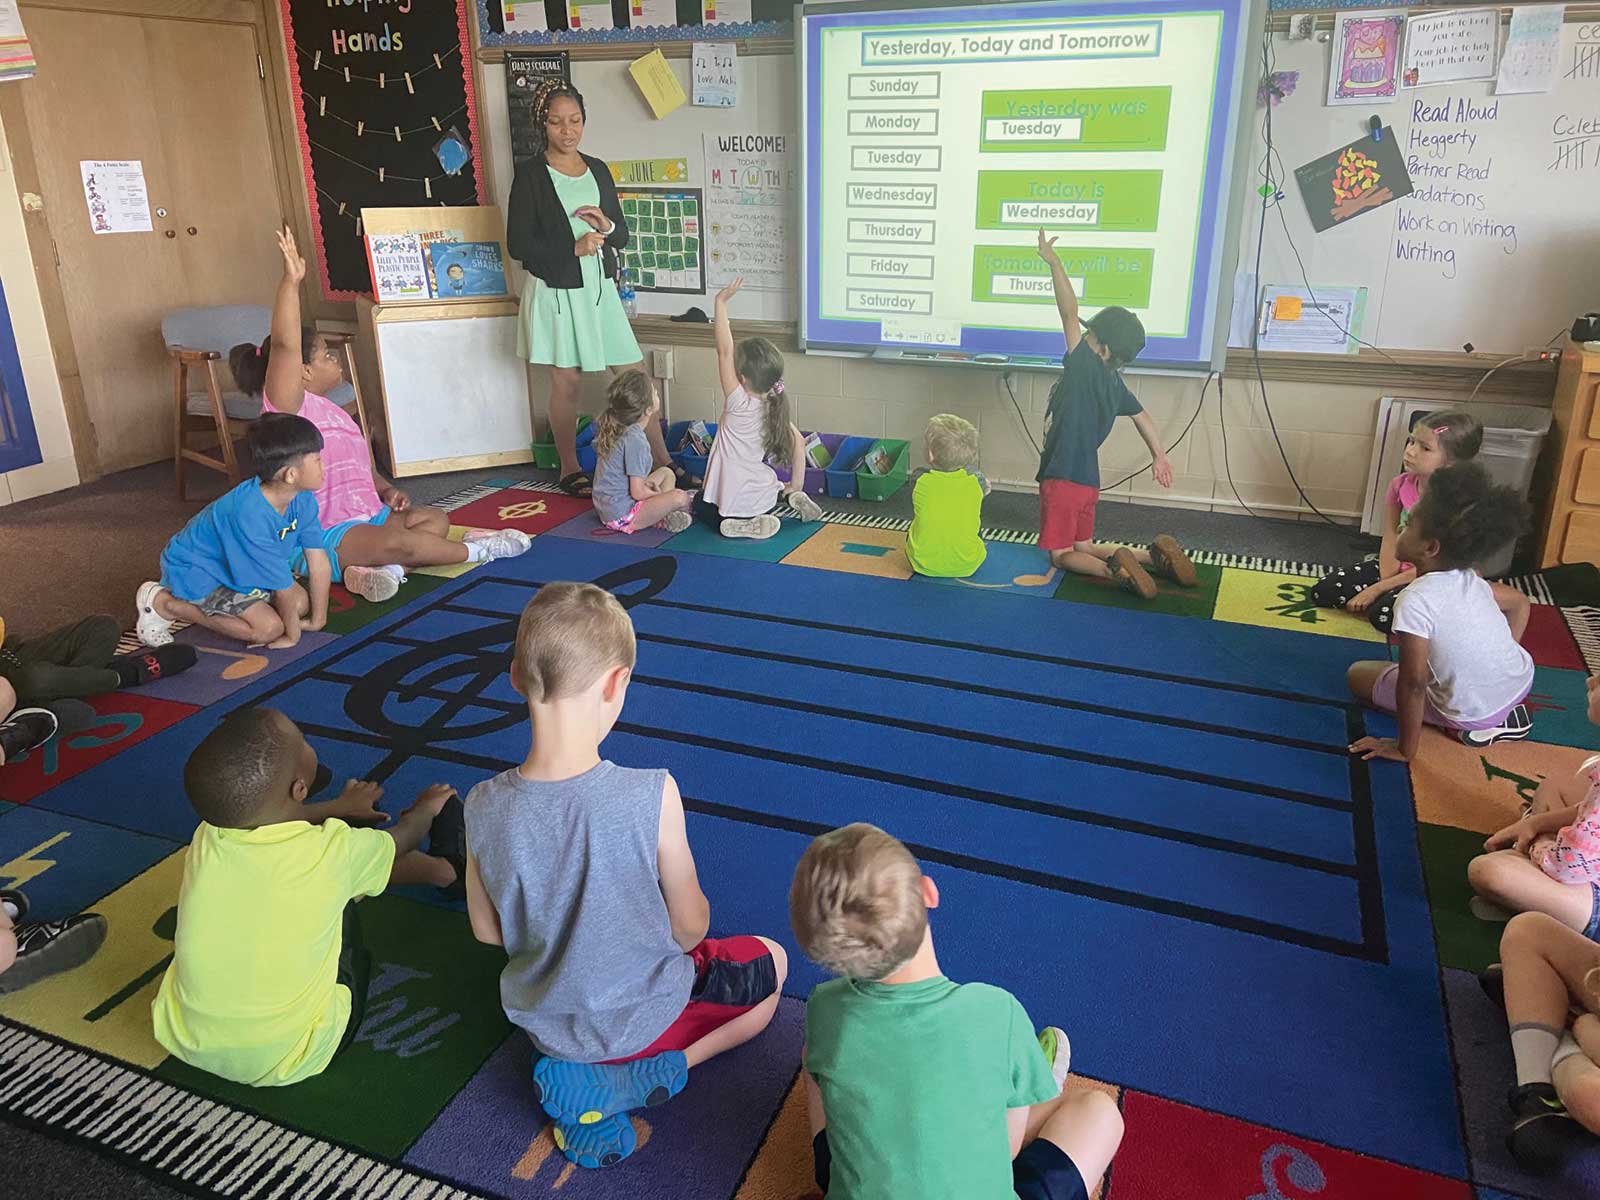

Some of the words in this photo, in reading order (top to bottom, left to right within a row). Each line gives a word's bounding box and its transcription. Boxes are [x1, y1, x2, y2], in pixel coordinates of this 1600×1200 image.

[331, 22, 404, 55] Hands
[870, 39, 956, 57] Yesterday,
[961, 36, 1014, 55] Today
[1019, 34, 1054, 50] and
[1059, 33, 1150, 50] Tomorrow
[869, 78, 919, 94] Sunday
[1006, 98, 1102, 120] Yesterday
[1108, 102, 1147, 116] was
[1413, 96, 1451, 123] Read
[1455, 97, 1498, 123] Aloud
[865, 114, 921, 131] Monday
[1002, 121, 1062, 137] Tuesday
[718, 135, 786, 152] WELCOME!
[1410, 128, 1477, 159] Heggerty
[867, 151, 922, 167] Tuesday
[1407, 154, 1453, 178] Partner
[1456, 157, 1491, 181] Read
[629, 161, 656, 182] JUNE
[712, 169, 722, 185] M
[730, 169, 738, 185] T
[853, 187, 933, 204] Wednesday
[1029, 181, 1086, 200] Today
[1092, 181, 1105, 198] is
[1407, 182, 1486, 211] undations
[1006, 204, 1096, 222] Wednesday
[419, 231, 445, 241] THREE
[865, 223, 922, 240] Thursday
[1398, 208, 1435, 232] Work
[1438, 220, 1458, 235] on
[1462, 216, 1518, 255] Writing
[870, 259, 909, 275] Friday
[1079, 255, 1109, 272] will
[1115, 256, 1141, 273] be
[1396, 239, 1457, 279] Writing
[1009, 277, 1054, 292] Thursd
[859, 294, 916, 311] Saturday
